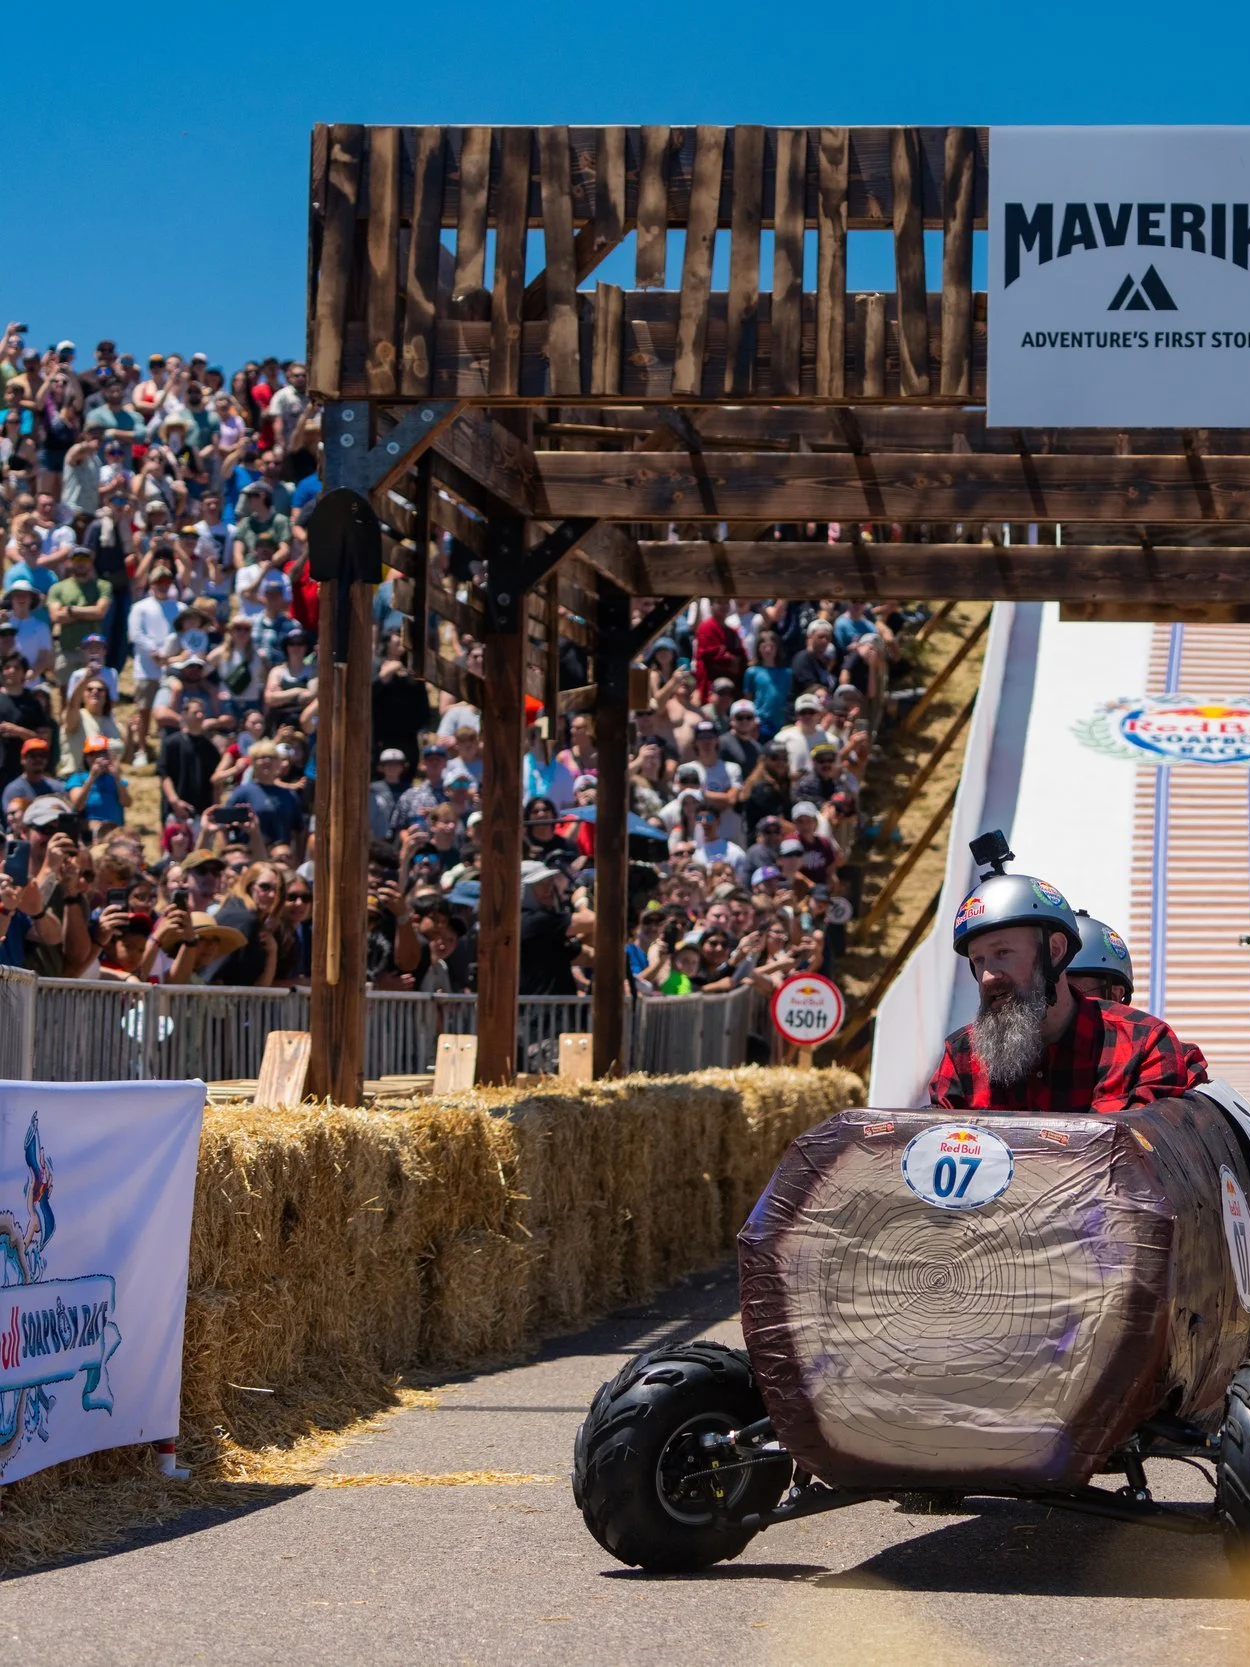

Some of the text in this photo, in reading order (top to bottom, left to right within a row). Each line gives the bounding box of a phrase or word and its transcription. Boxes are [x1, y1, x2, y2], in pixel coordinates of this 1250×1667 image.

[1021, 331, 1149, 348] ADVENTURE'S
[1154, 331, 1206, 348] FIRST
[1127, 720, 1209, 734] Red
[967, 905, 985, 918] Bull
[940, 1142, 981, 1156] Red Bull
[933, 1156, 983, 1198] 07
[1233, 1221, 1250, 1296] 07
[0, 1306, 20, 1370] ull
[21, 1298, 79, 1359] SOAPBOX
